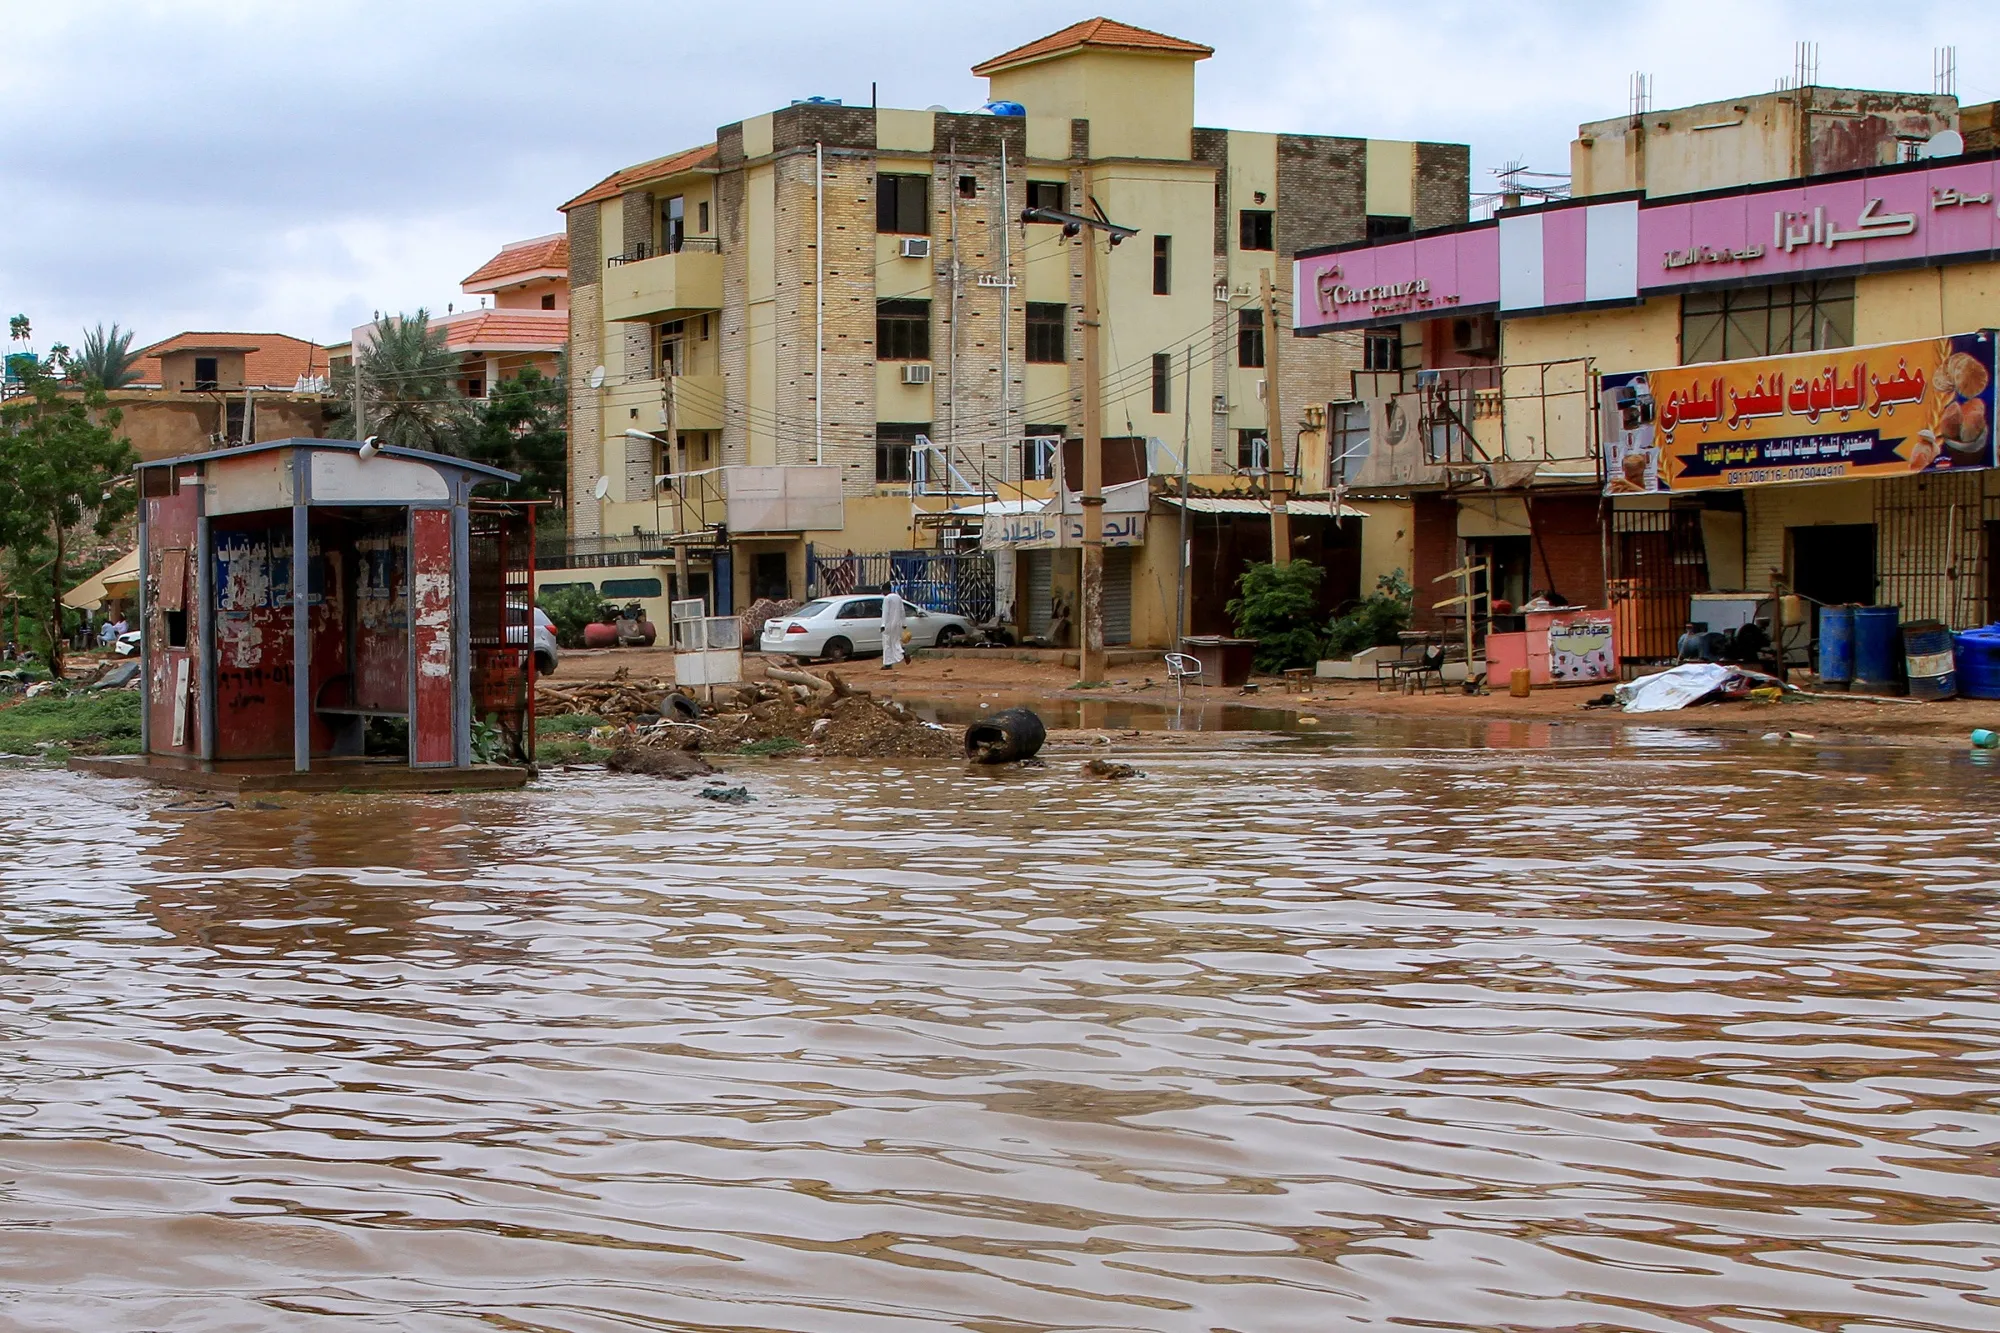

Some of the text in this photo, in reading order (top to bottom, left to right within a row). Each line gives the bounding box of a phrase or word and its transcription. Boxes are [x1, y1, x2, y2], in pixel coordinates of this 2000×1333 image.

[1931, 186, 1992, 210] مركز
[1773, 198, 1918, 253] كرانزا
[1333, 277, 1430, 304] Carranza
[1660, 356, 1927, 444] مخبز الياقوت للخبز البلدي
[1841, 435, 1873, 457] مستعدون
[1728, 469, 1781, 485] 0911206116
[1788, 465, 1844, 480] 0129044910
